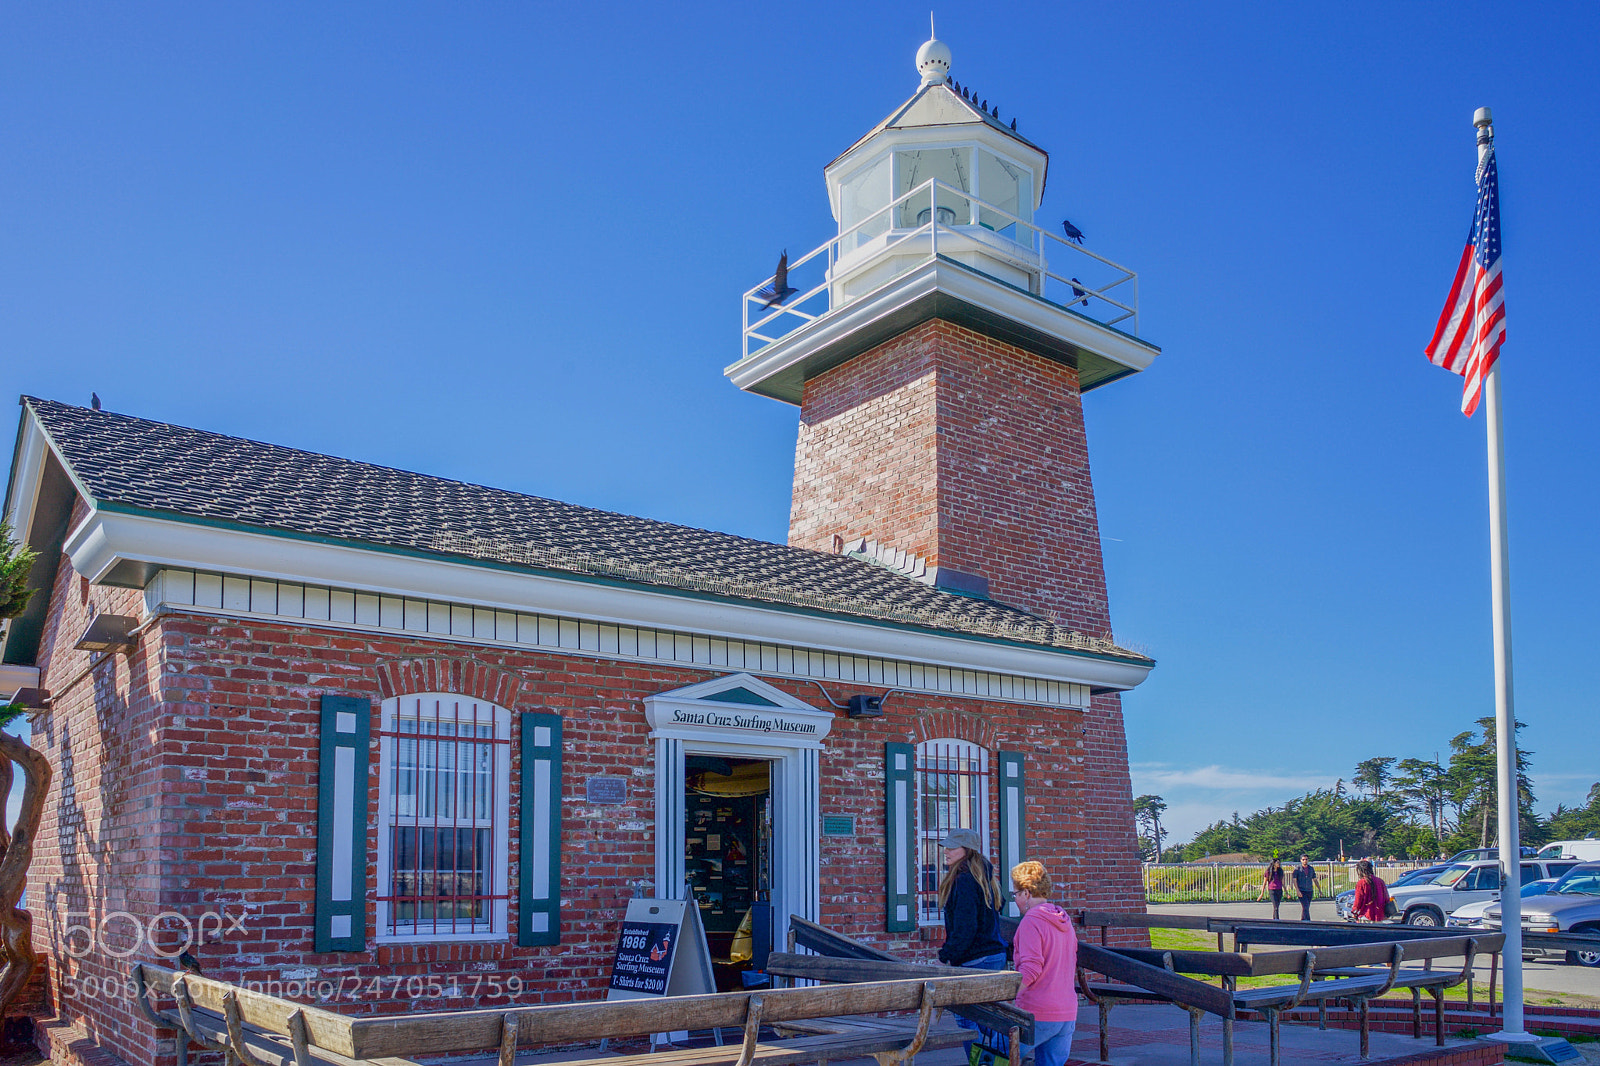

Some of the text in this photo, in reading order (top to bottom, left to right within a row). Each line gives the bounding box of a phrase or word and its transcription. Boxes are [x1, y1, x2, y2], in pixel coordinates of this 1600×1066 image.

[673, 709, 816, 733] Santa Cruz Surfing Museum
[623, 928, 649, 936] Established
[622, 935, 647, 949] 1986
[618, 952, 649, 963] Santa Cruz
[616, 962, 665, 974] Surfing Museum
[635, 978, 644, 988] for
